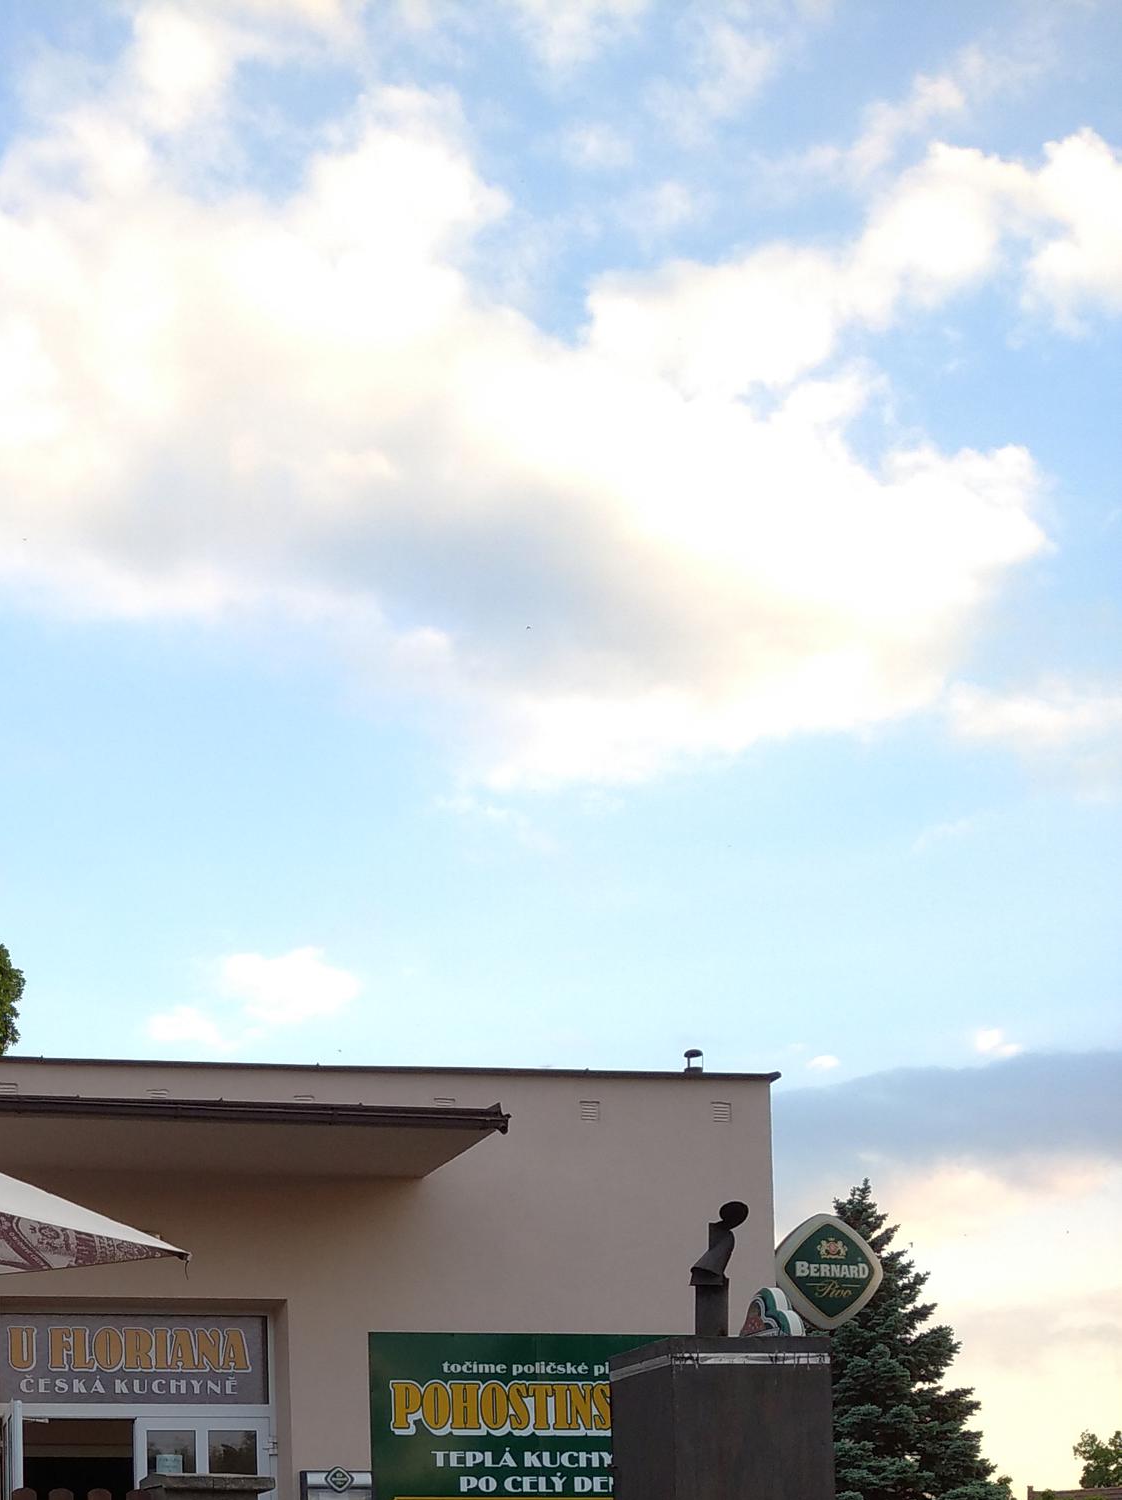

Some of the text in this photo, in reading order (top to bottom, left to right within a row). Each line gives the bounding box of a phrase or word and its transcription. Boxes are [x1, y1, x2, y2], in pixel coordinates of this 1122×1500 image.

[795, 1260, 869, 1279] BERNARD
[7, 1326, 252, 1374] U FLORIANA
[442, 1361, 508, 1374] točíme
[512, 1360, 589, 1375] poličské
[20, 1373, 239, 1395] ČESKÁ KUCHYNĚ
[390, 1379, 612, 1436] POHOSTINS
[431, 1447, 517, 1467] TEPLÁ
[460, 1476, 497, 1492] PO
[504, 1472, 566, 1493] CELÝ
